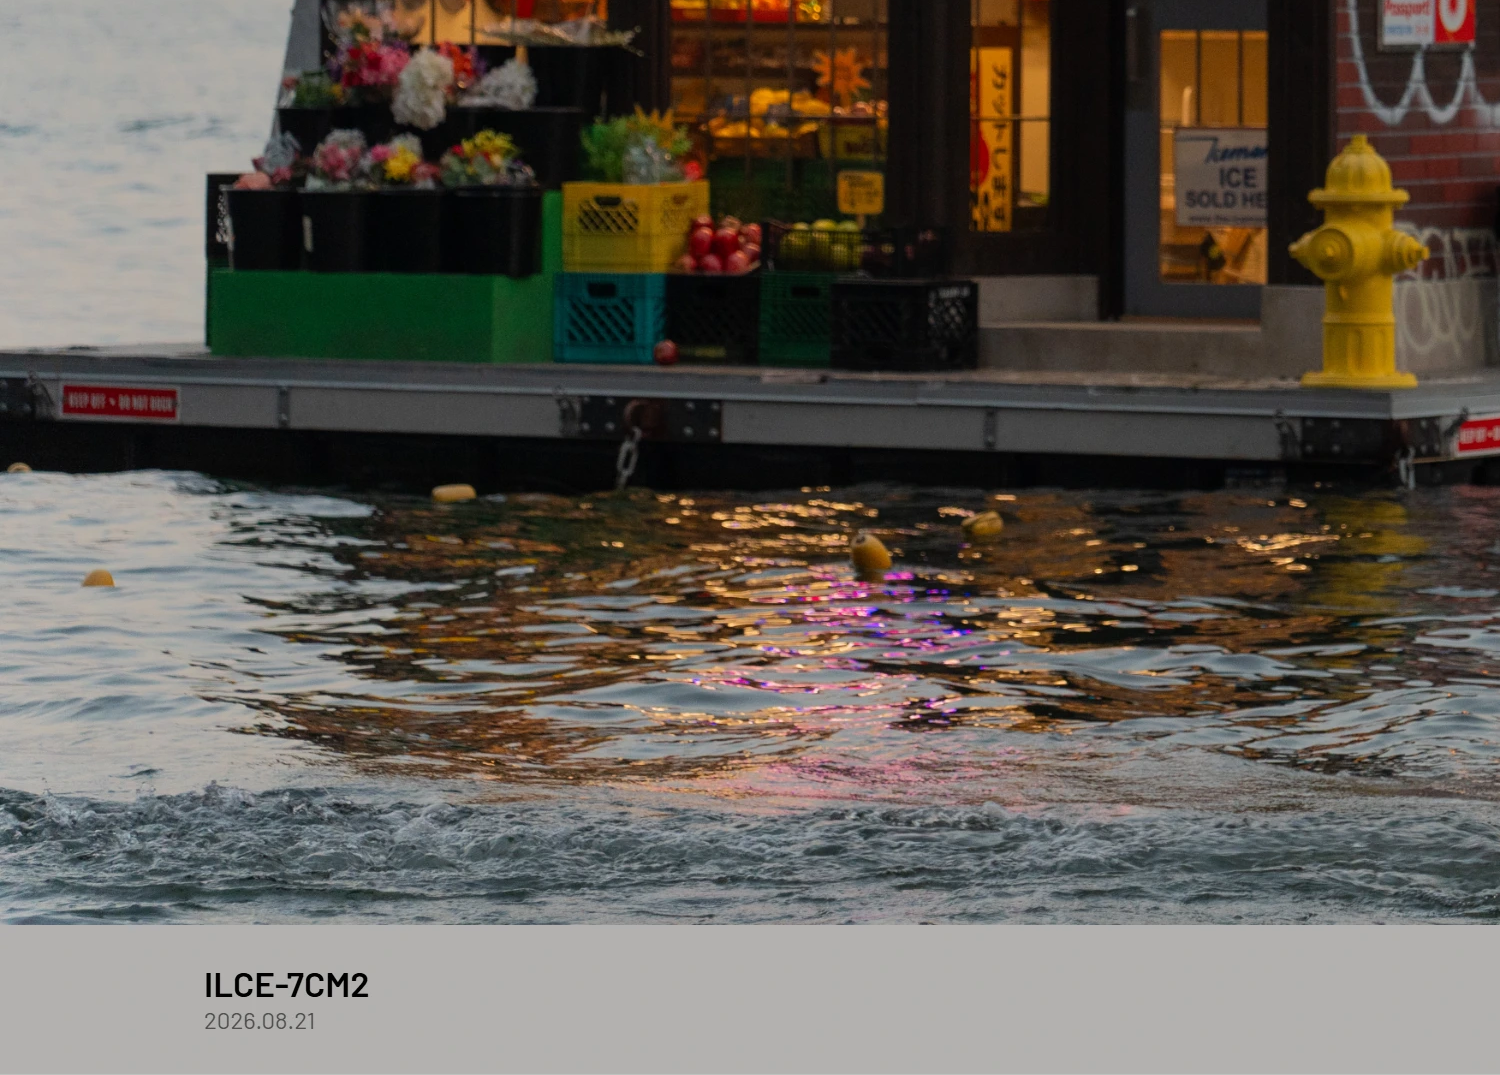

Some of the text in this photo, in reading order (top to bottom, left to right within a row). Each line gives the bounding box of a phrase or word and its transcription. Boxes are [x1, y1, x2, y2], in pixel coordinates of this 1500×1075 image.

[1219, 168, 1256, 188] ICE
[1185, 190, 1267, 209] SOLD HE
